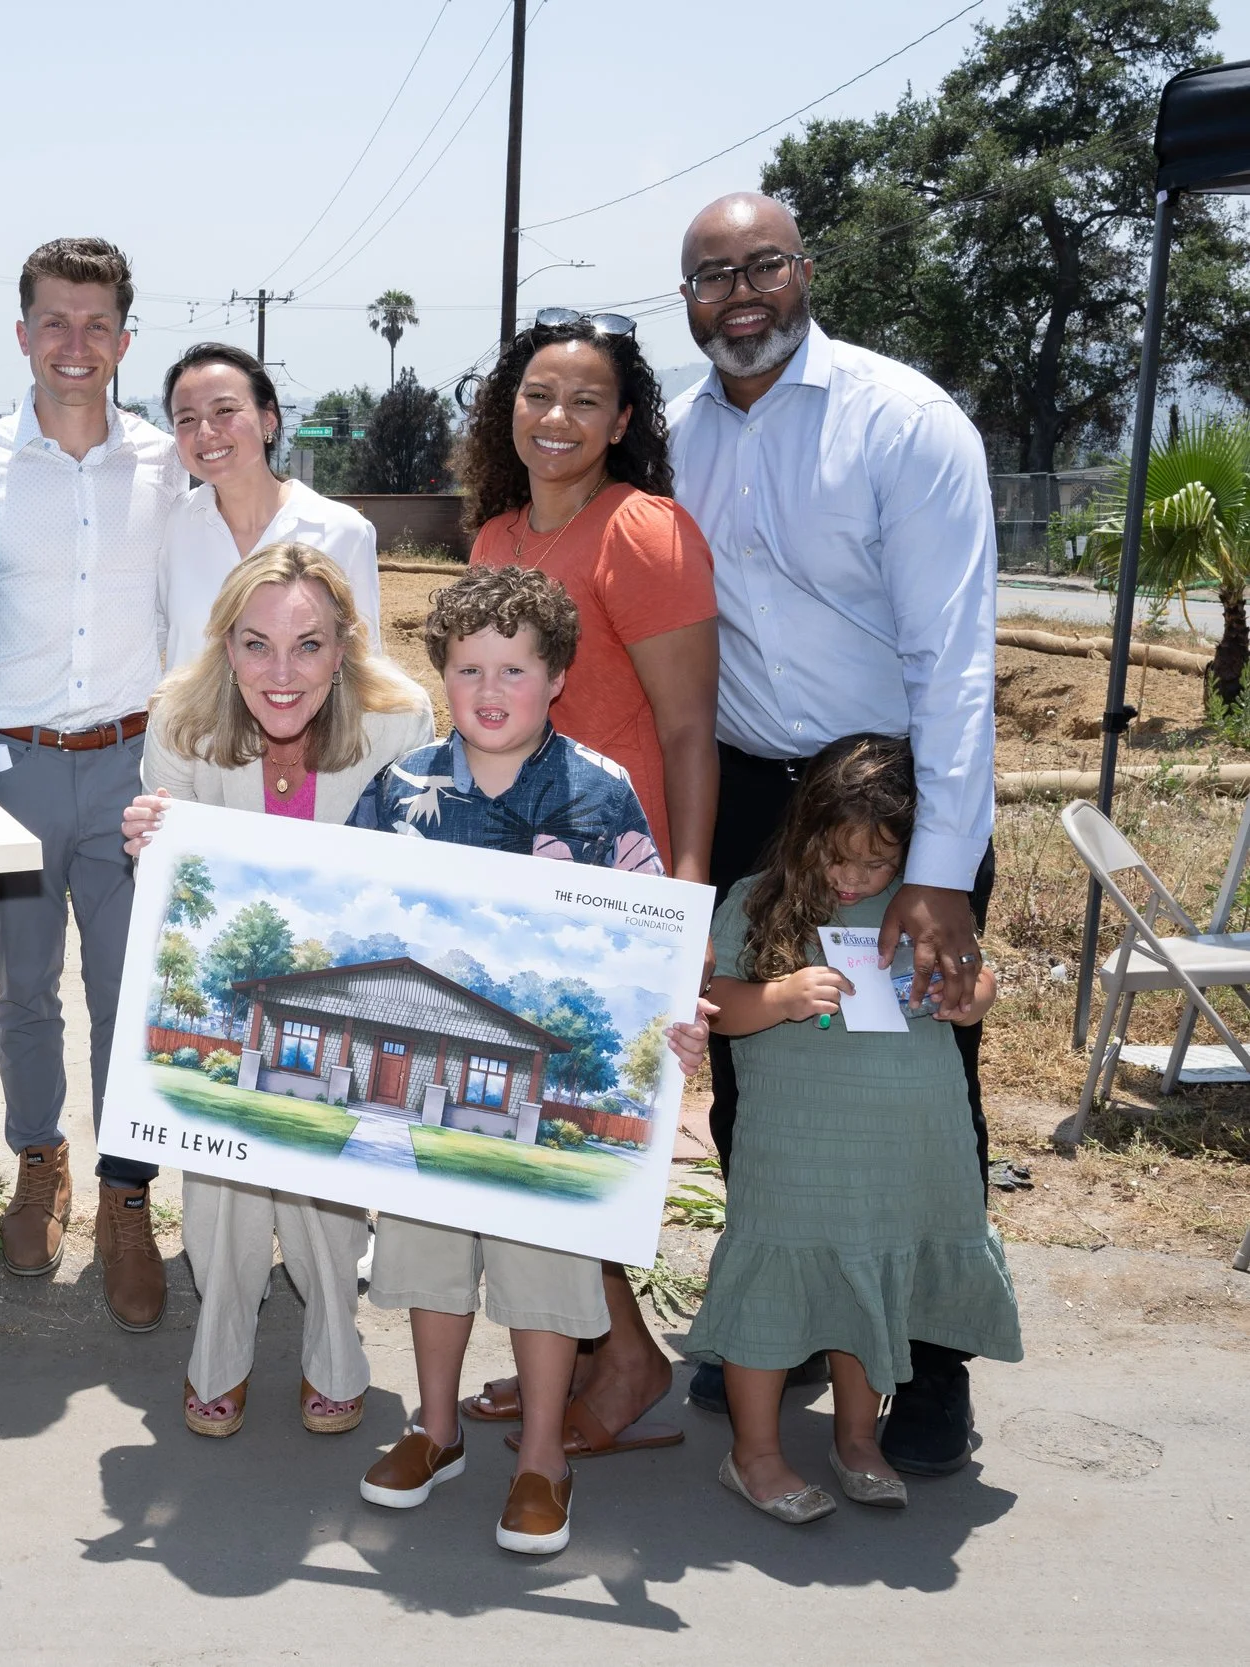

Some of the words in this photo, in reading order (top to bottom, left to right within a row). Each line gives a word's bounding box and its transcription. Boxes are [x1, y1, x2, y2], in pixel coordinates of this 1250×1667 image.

[555, 890, 573, 902] THE
[576, 894, 628, 912] FOOTHILL
[632, 903, 685, 921] CATALOG
[625, 916, 683, 933] FOUNDATION
[130, 1121, 168, 1145] THE
[180, 1131, 248, 1160] LEWIS
